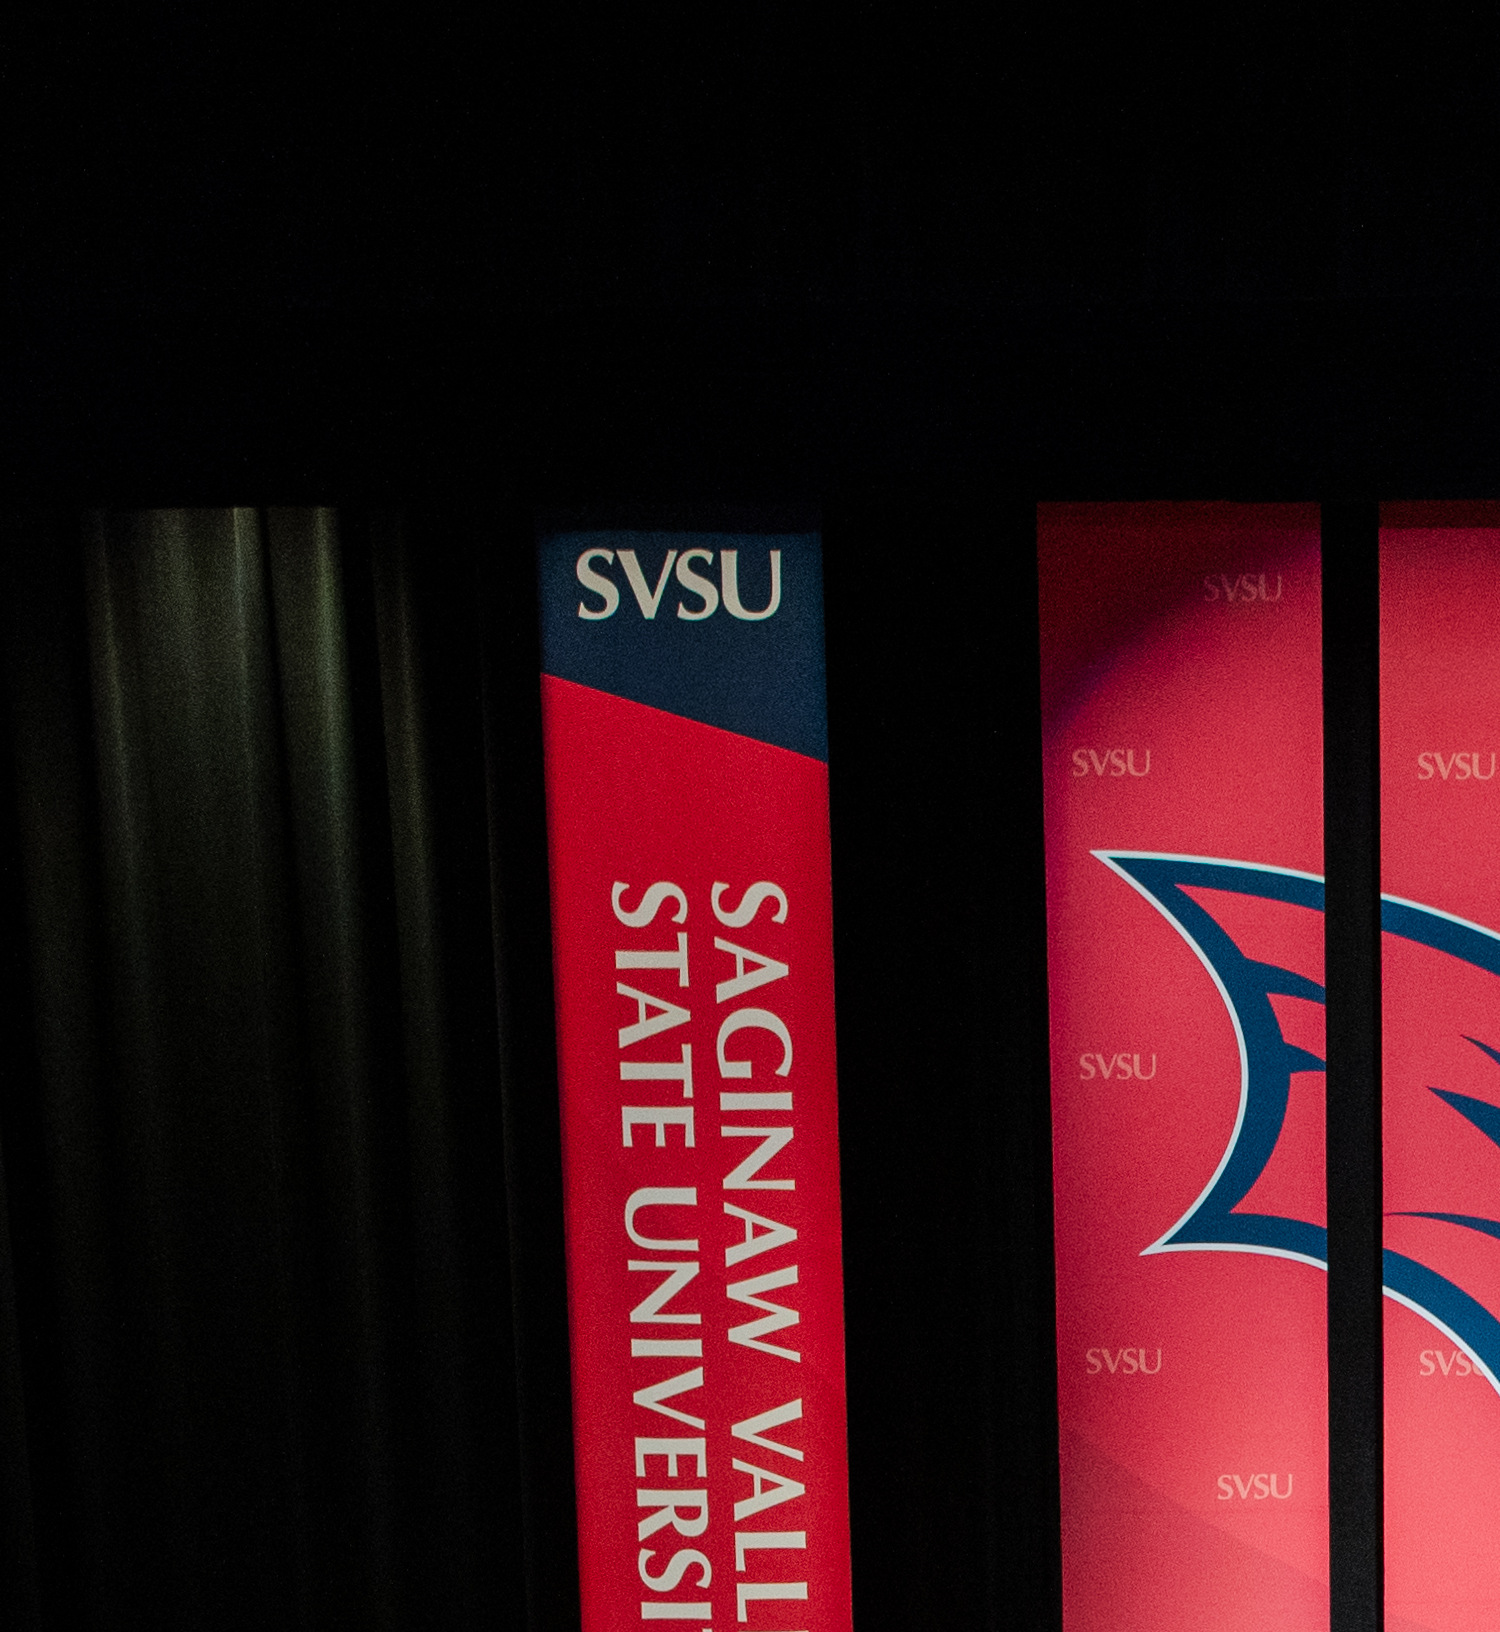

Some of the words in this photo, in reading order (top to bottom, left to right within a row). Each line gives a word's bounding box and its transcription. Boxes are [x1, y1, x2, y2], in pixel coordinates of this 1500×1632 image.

[576, 548, 782, 622] SVSU
[1203, 574, 1282, 603] SVSU
[1073, 749, 1152, 778] SVSU
[1417, 752, 1496, 781] SVSU
[611, 881, 696, 1148] STATE
[1080, 1052, 1158, 1081] SVSU
[710, 881, 801, 1363] SAGINAW
[1086, 1347, 1163, 1375] SVSU
[1217, 1473, 1294, 1500] SVSU
